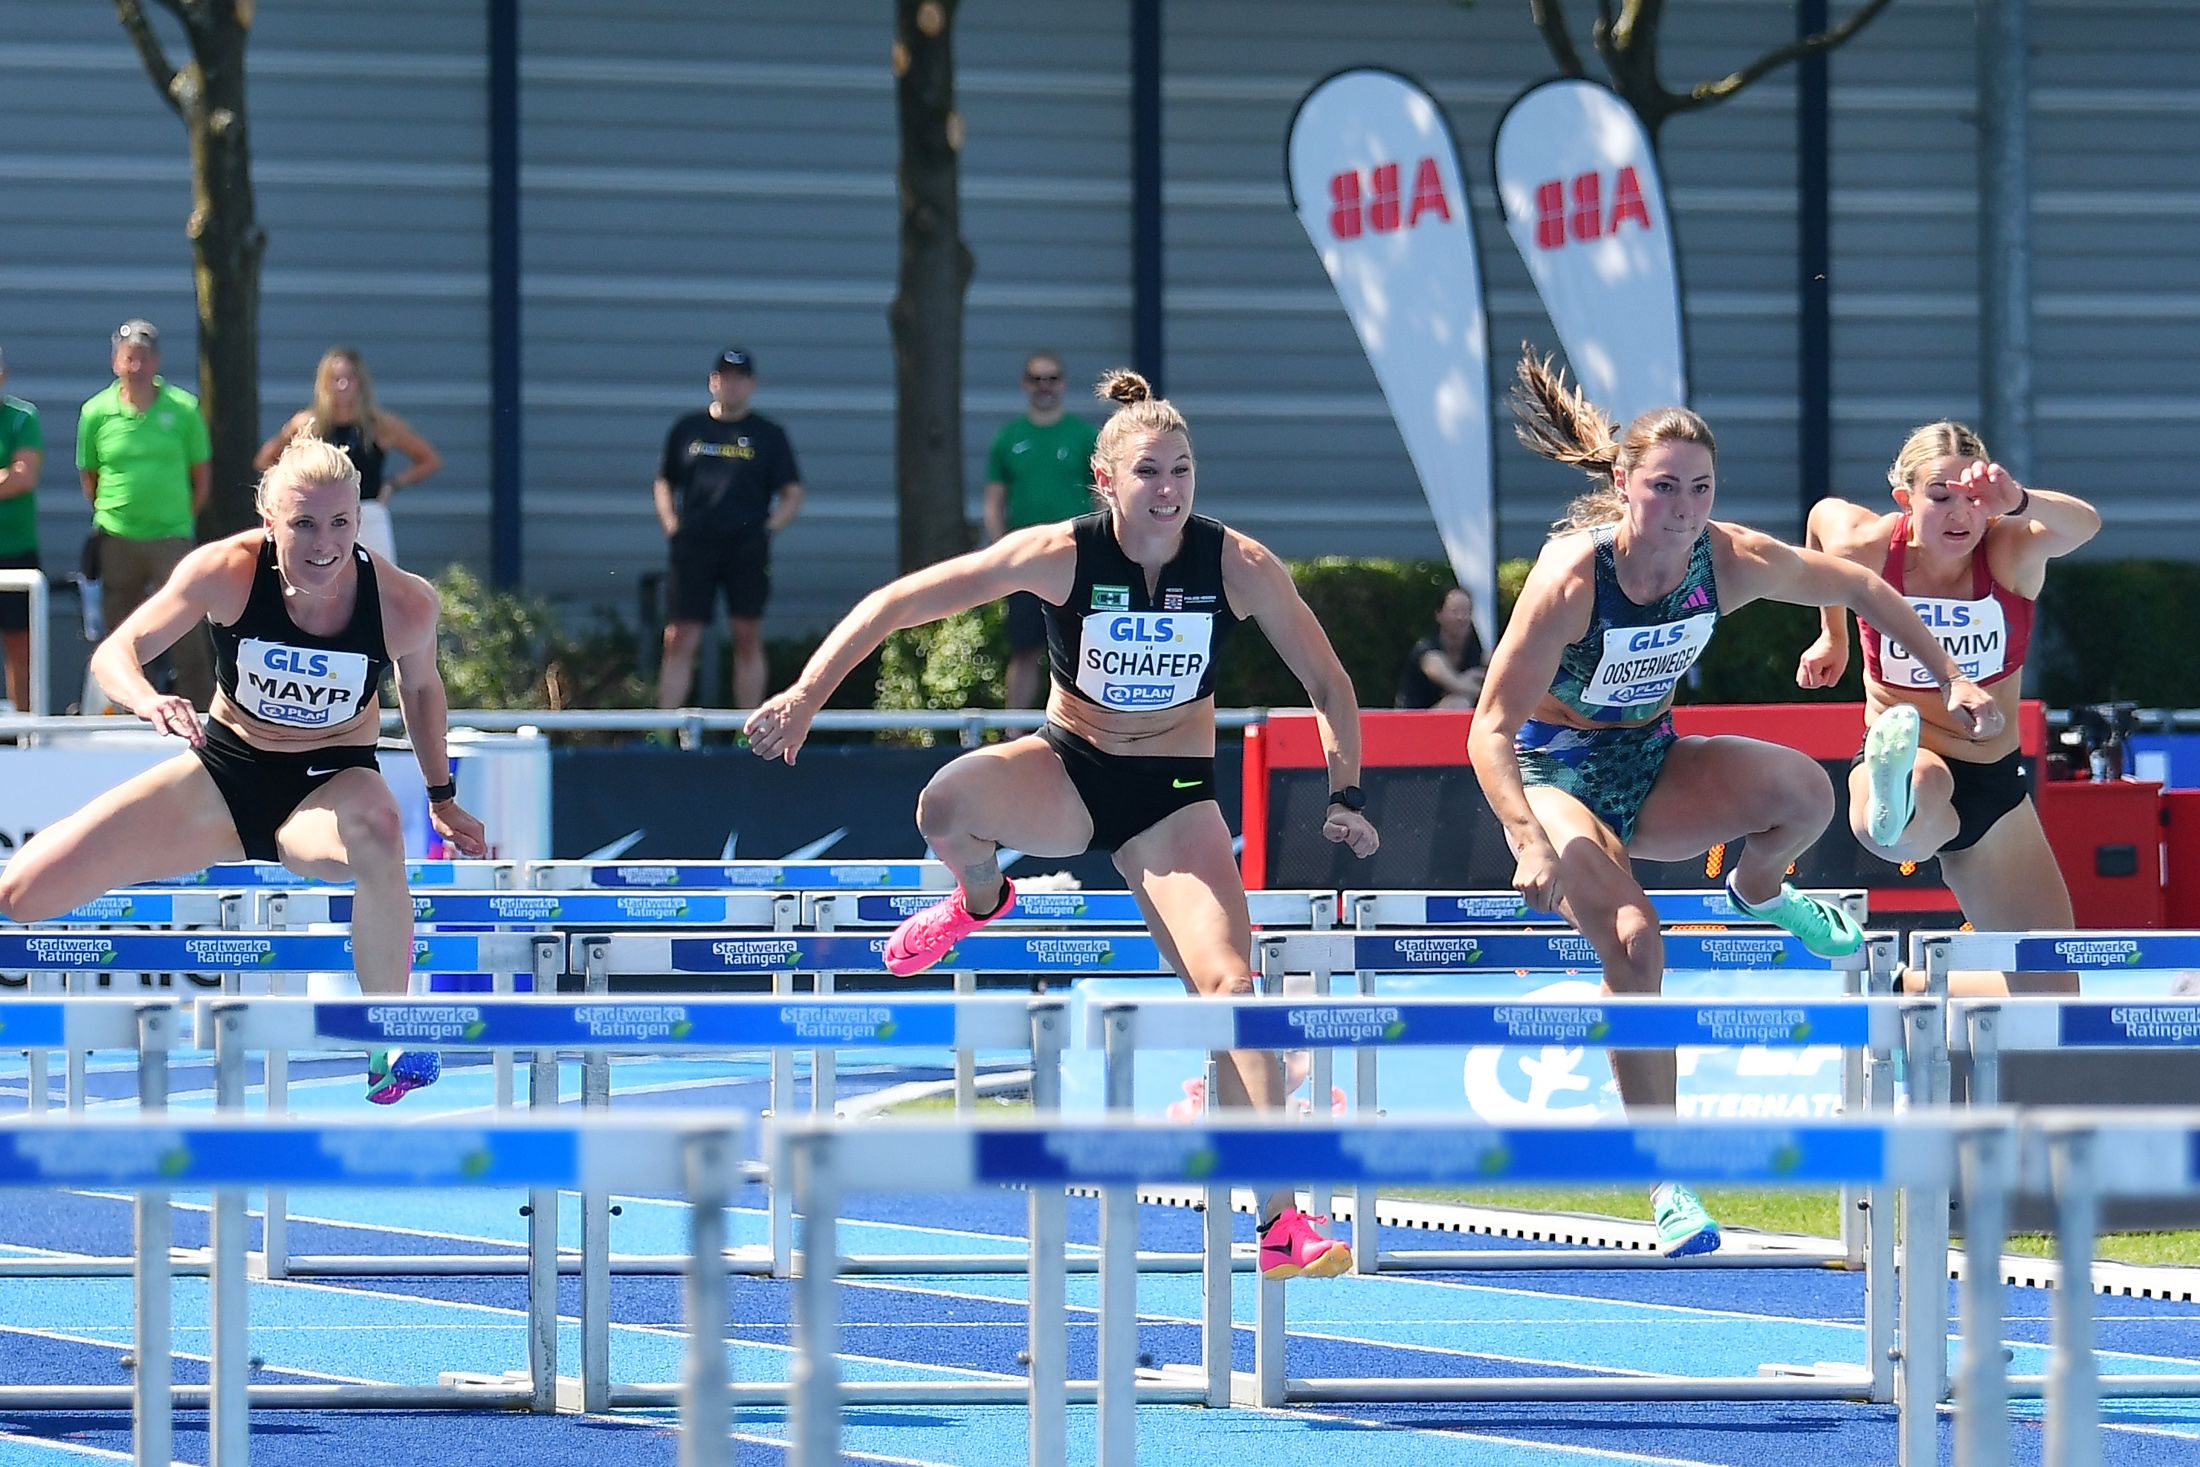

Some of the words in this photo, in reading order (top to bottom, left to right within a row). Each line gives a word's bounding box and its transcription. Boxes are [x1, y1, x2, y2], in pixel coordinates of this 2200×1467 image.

[1889, 630, 1998, 660] GMM
[1086, 645, 1203, 677] SCHÄFER
[248, 672, 351, 706] MAYR
[1132, 688, 1173, 699] PLAN
[1635, 680, 1674, 694] PLAN
[287, 707, 326, 720] PLAN
[499, 908, 549, 920] Ratingen
[627, 908, 677, 919] Ratingen
[1025, 905, 1075, 917] Ratingen
[1467, 907, 1516, 918] Ratingen
[27, 939, 112, 951] Stadtwerke
[186, 940, 271, 952] Stadtwerke
[713, 941, 797, 953] Stadtwerke
[1026, 941, 1110, 952] Stadtwerke
[1395, 939, 1478, 951] Stadtwerke
[1701, 940, 1784, 952] Stadtwerke
[2055, 941, 2137, 954] Stadtwerke
[38, 950, 100, 965] Ratingen
[197, 951, 259, 965] Ratingen
[725, 953, 786, 967] Ratingen
[1038, 951, 1099, 965] Ratingen
[1406, 950, 1466, 964] Ratingen
[1560, 949, 1602, 964] Rating
[1712, 951, 1772, 965] Ratingen
[2066, 952, 2126, 966] Ratingen
[367, 1007, 479, 1023] Stadtwerke
[575, 1007, 685, 1023] Stadtwerke
[781, 1008, 890, 1023] Stadtwerke
[1288, 1008, 1398, 1026] Stadtwerke
[1494, 1007, 1603, 1023] Stadtwerke
[1696, 1009, 1805, 1025] Stadtwerke
[383, 1022, 463, 1040] Ratingen
[590, 1021, 670, 1040] Ratingen
[796, 1022, 875, 1041] Ratingen
[1304, 1023, 1383, 1042] Ratingen
[1508, 1021, 1587, 1041] Ratingen
[1712, 1024, 1790, 1043] Ratingen
